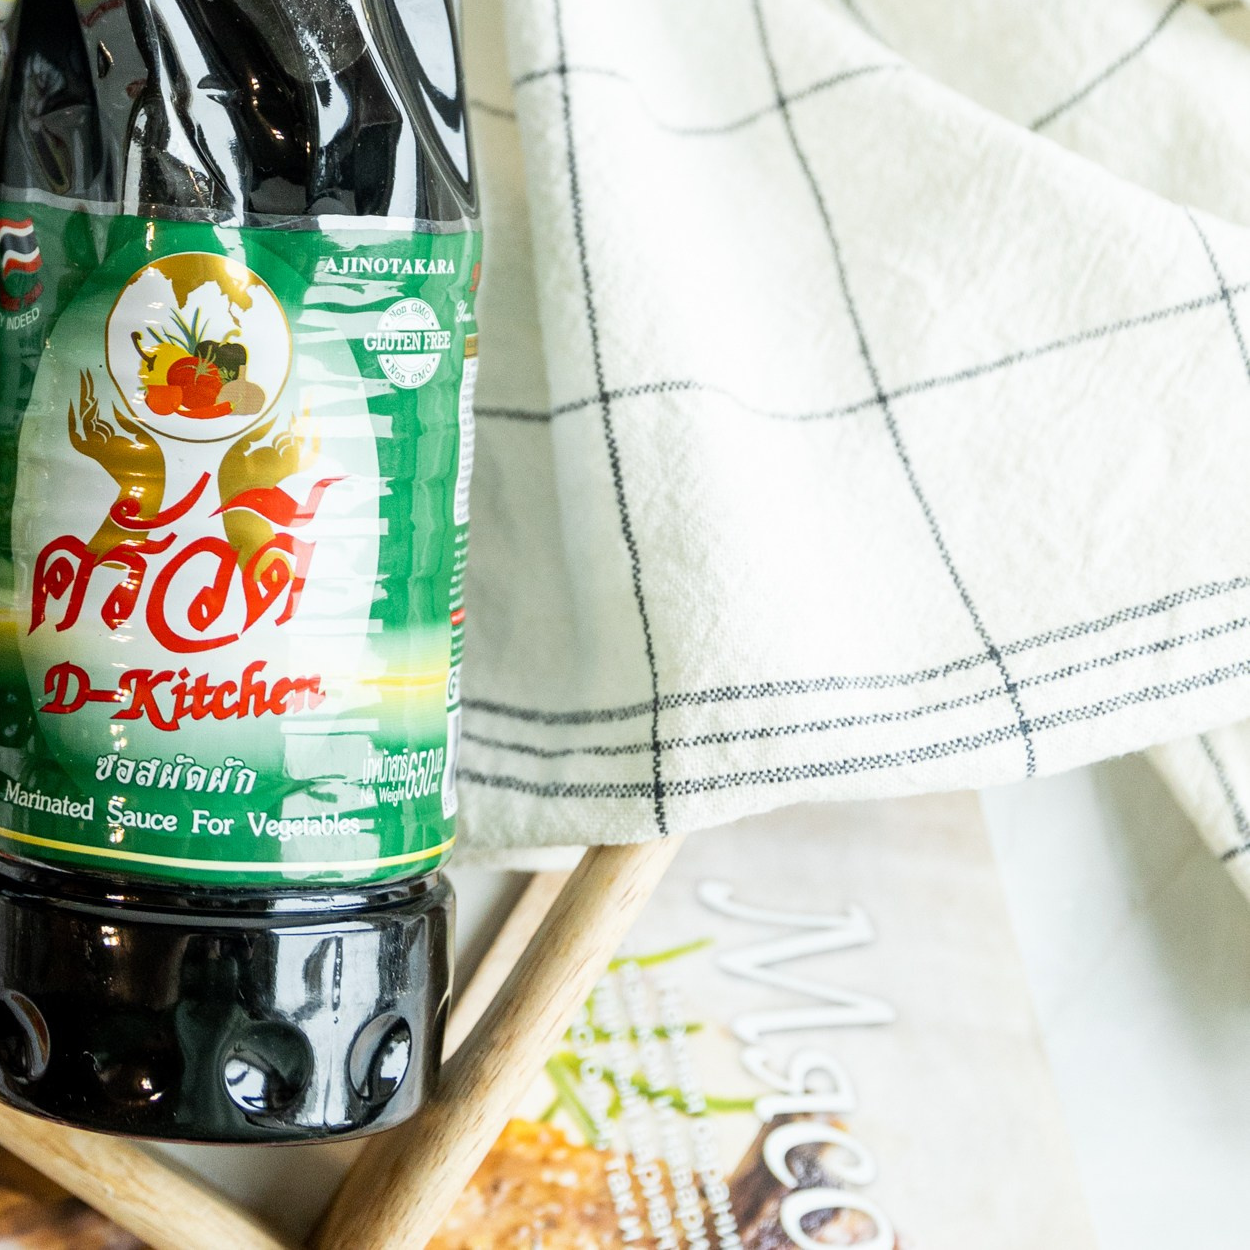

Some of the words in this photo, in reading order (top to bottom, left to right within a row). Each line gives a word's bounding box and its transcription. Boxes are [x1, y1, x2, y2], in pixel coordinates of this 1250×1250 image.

[324, 257, 456, 274] AJINOTAKARA
[6, 308, 41, 331] INDEED
[389, 306, 408, 321] Non
[411, 302, 432, 321] GMO
[363, 331, 422, 352] GLUTEN
[423, 330, 452, 350] FREE
[388, 363, 406, 384] Non
[411, 363, 433, 384] GMO
[39, 661, 327, 731] D-Kitchen
[94, 754, 257, 794] ซอสผัดผัก
[405, 749, 435, 800] 650
[3, 779, 94, 820] Marinated
[106, 799, 178, 831] Sauce
[191, 809, 235, 836] For
[247, 812, 361, 842] Vegetables
